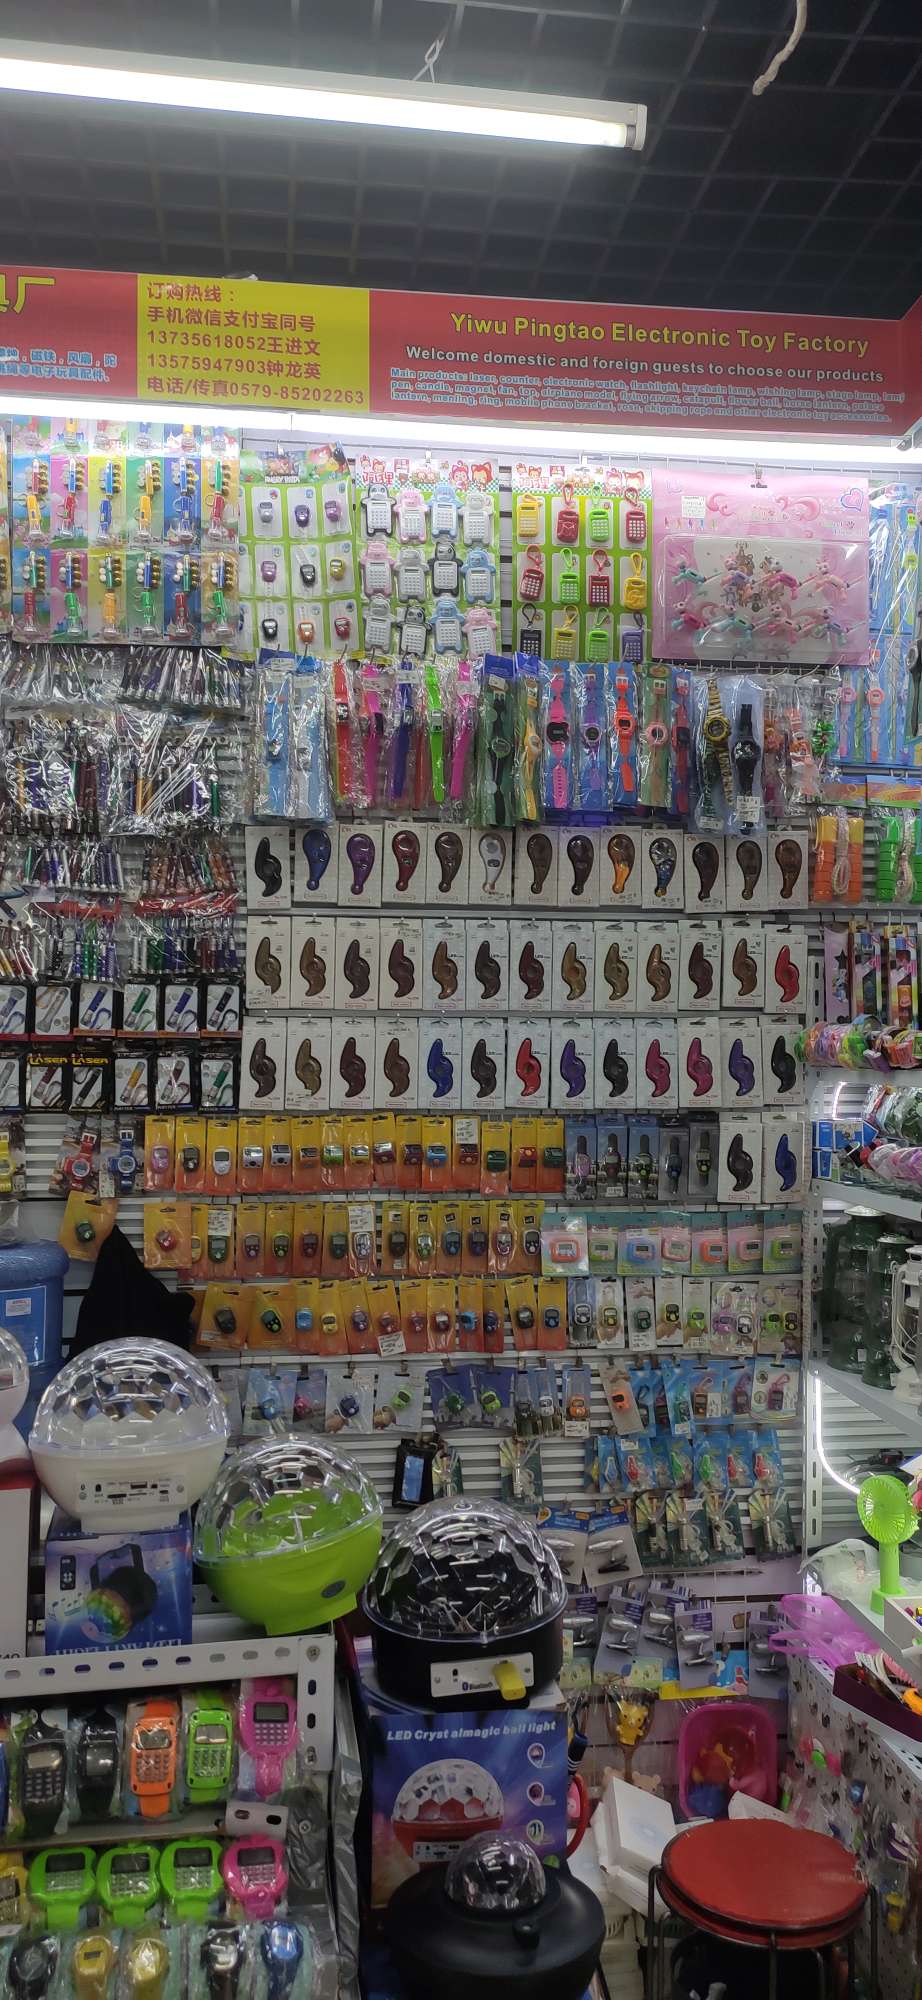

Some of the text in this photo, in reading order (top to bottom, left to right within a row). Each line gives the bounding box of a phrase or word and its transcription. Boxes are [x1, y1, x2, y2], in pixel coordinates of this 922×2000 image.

[147, 306, 316, 333] 手机微信支付宝同号
[147, 330, 321, 356] 13735618052王进文
[450, 313, 869, 358] Yiwu Pingtao Electronic Toy Factory
[147, 353, 321, 380] 13575947903钟龙英
[406, 346, 884, 382] Welcome domestic and foreign guests to choose our products
[147, 376, 364, 404] 电话/传真0579-85202263
[391, 368, 416, 378] Main
[543, 377, 595, 387] electronic
[505, 397, 540, 407] mobile
[541, 399, 573, 409] phone
[541, 387, 583, 398] airplane
[72, 1057, 109, 1066] LASER
[386, 1729, 412, 1741] LED
[414, 1728, 449, 1741] Cryst
[502, 1724, 526, 1735] ball
[527, 1721, 556, 1734] light
